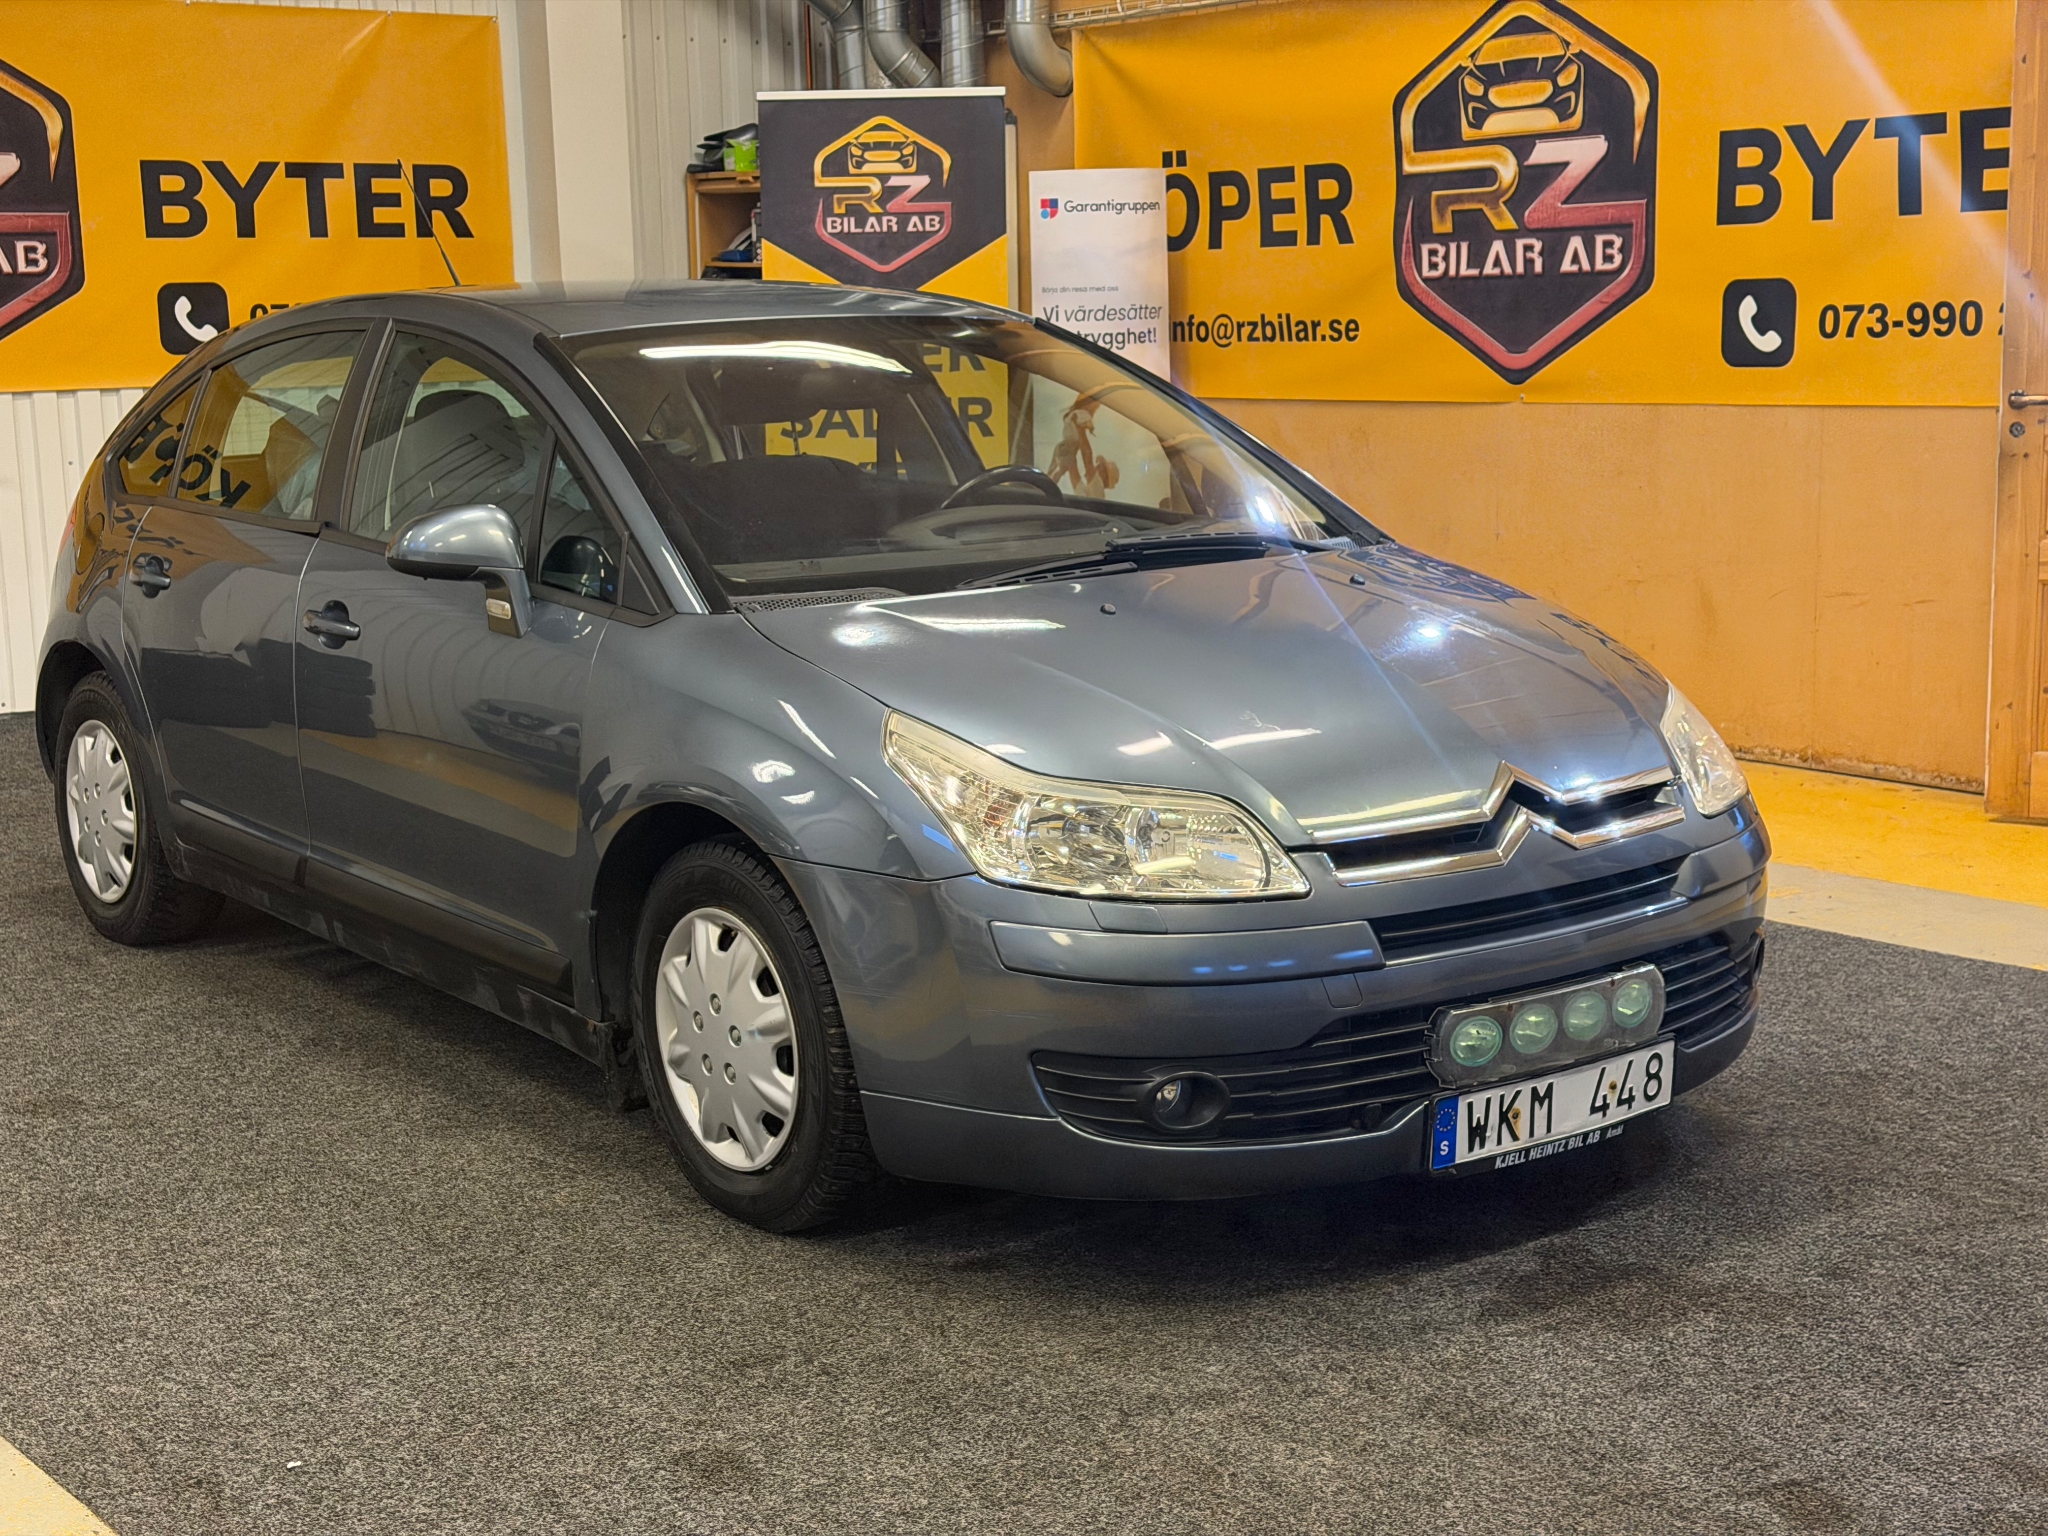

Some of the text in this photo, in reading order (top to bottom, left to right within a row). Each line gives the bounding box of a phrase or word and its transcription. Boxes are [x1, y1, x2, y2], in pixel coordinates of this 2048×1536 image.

[1716, 106, 2012, 226] BYTE
[139, 159, 475, 239] BYTER
[1064, 199, 1161, 215] Garantigruppen
[1162, 150, 1355, 252] ÖPER
[826, 215, 941, 234] BILAR AB
[1420, 234, 1623, 280] BILAR AB
[1043, 304, 1162, 322] Vi värdesätter
[1168, 313, 1360, 348] nfo@rzbilar.se
[1818, 300, 1984, 339] 073-990
[1467, 1051, 1663, 1154] WKM 448
[1440, 1141, 1449, 1156] S
[1495, 1150, 1526, 1169] KJELL
[1529, 1139, 1566, 1161] HEINTZ
[1568, 1134, 1584, 1150] BIL
[1586, 1130, 1601, 1146] AB
